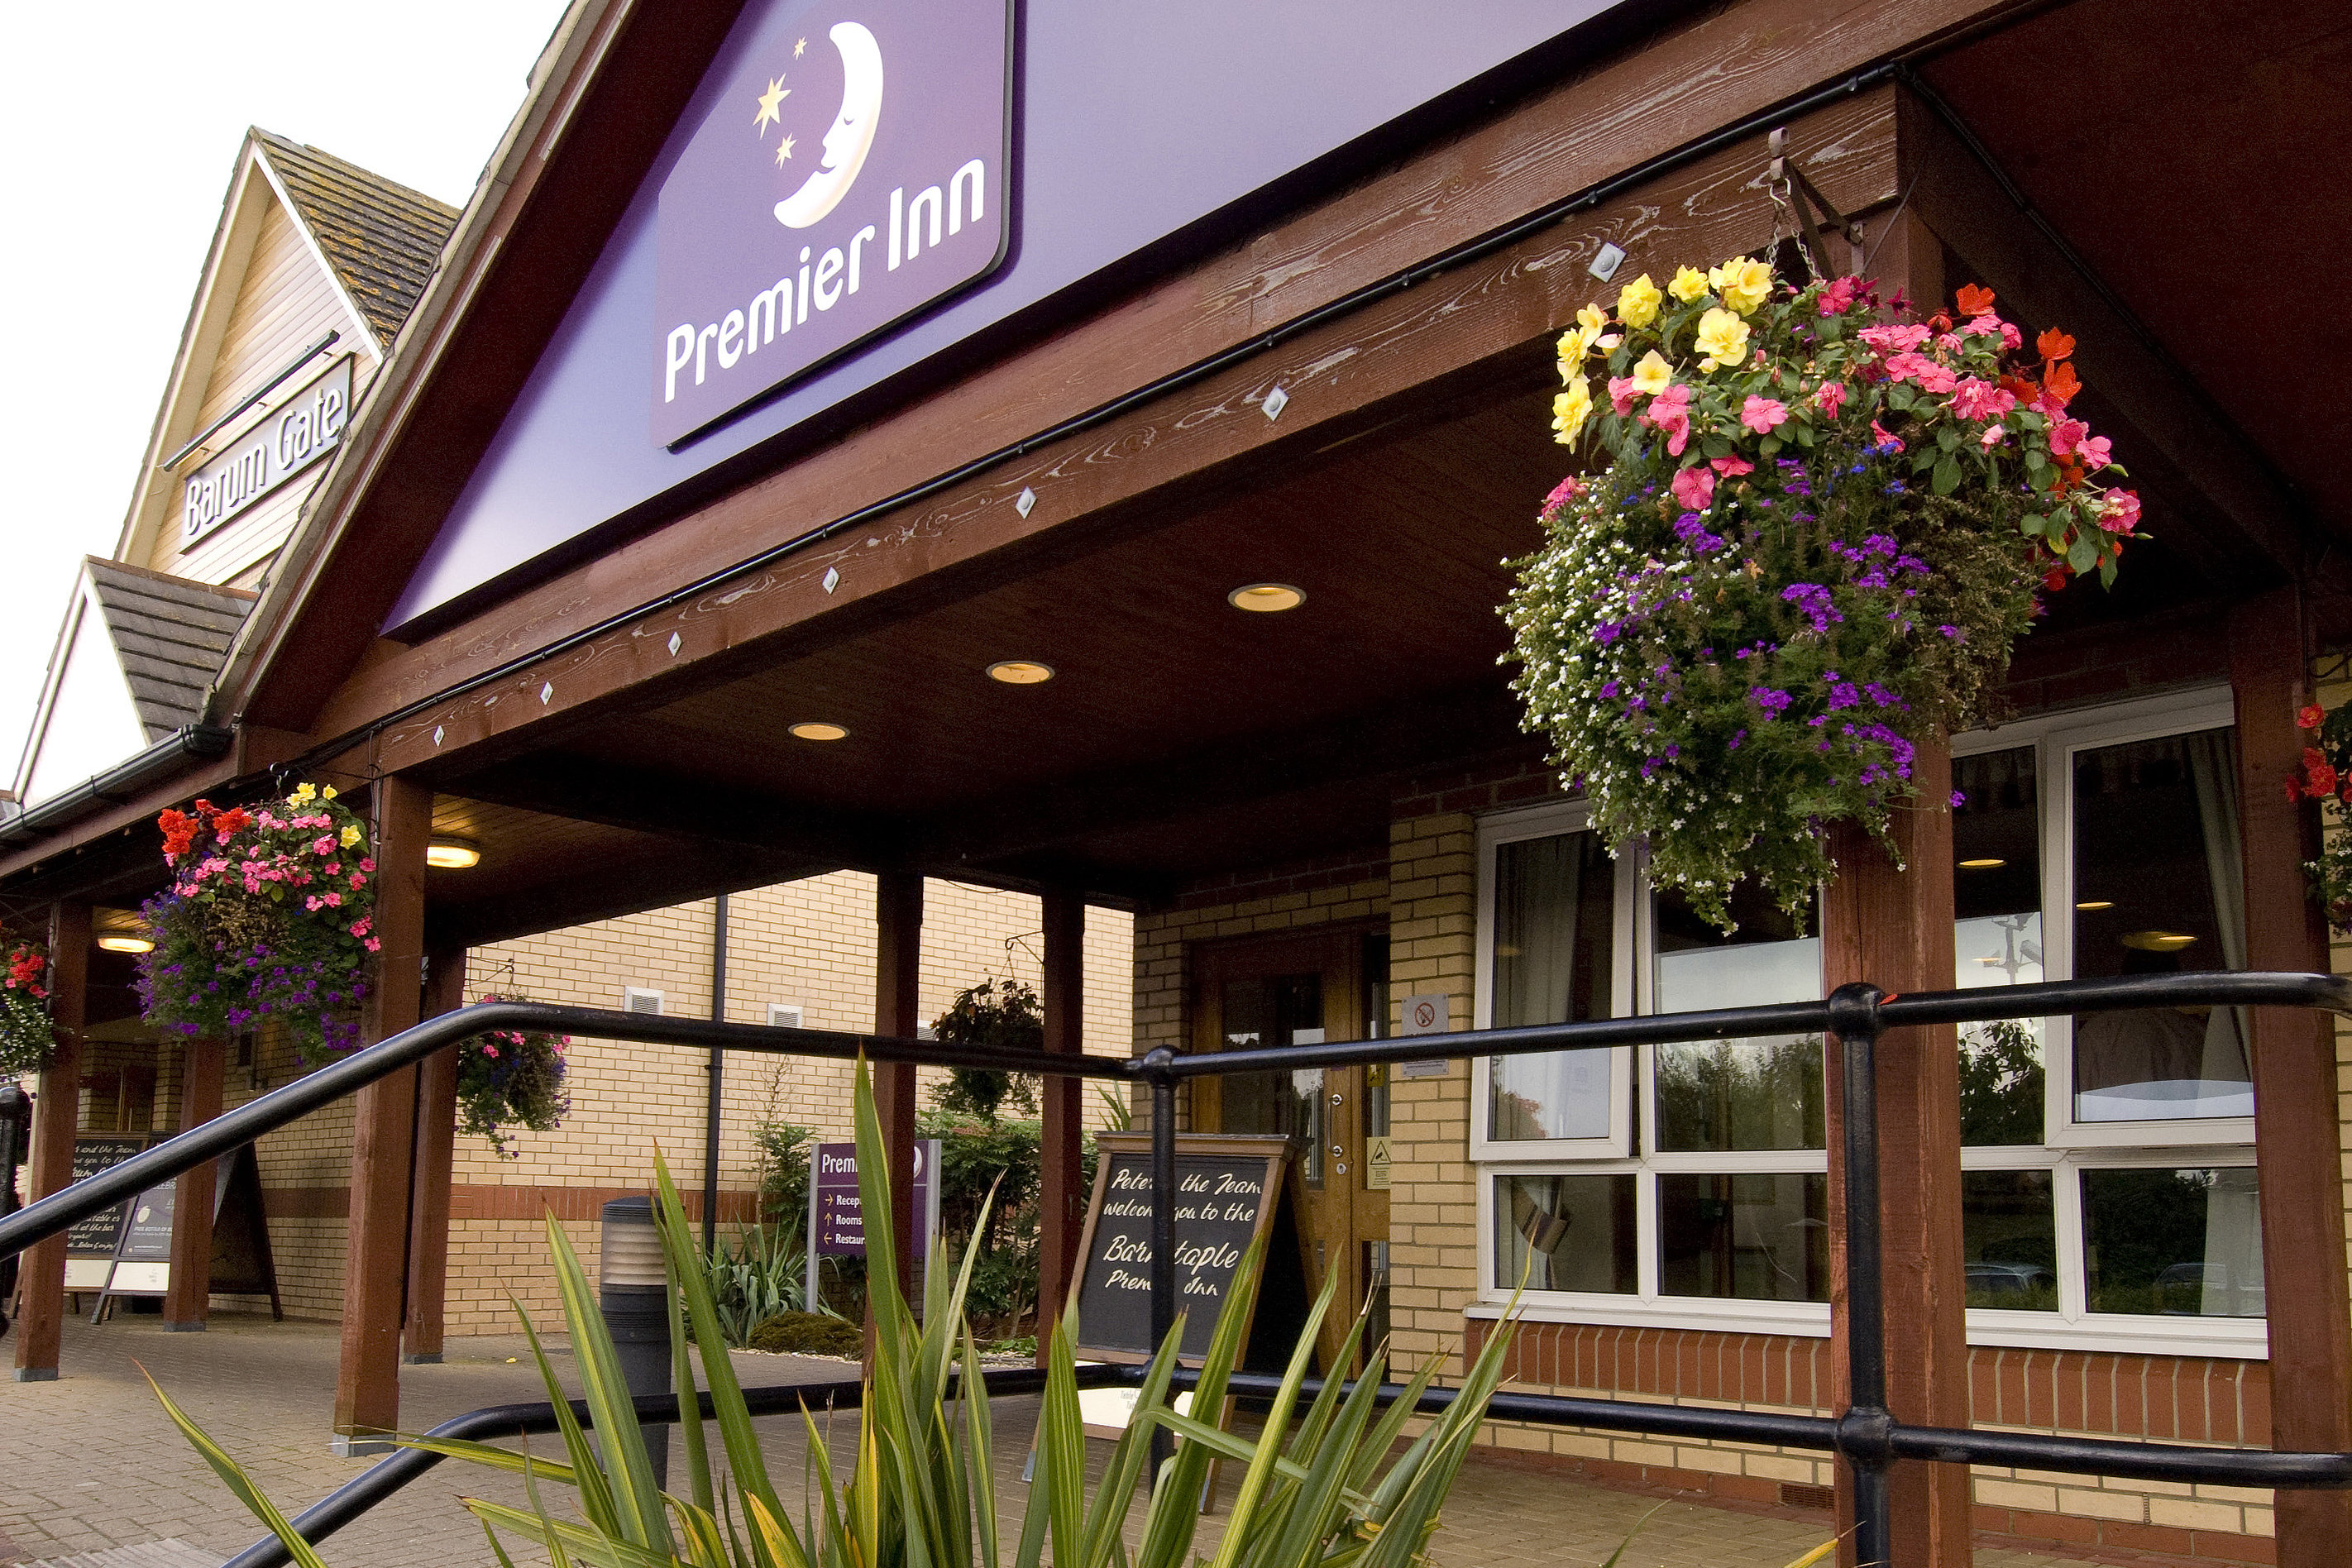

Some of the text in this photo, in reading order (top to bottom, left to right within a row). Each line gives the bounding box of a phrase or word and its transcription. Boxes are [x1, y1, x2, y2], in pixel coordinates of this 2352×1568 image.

[665, 158, 984, 404] Premier Inn
[184, 388, 342, 535] Barum Gate
[821, 1154, 858, 1174] Prem
[1180, 1174, 1209, 1193] the
[1213, 1173, 1262, 1195] Team
[836, 1195, 861, 1208] Recep
[1103, 1199, 1152, 1217] welco
[1200, 1203, 1219, 1221] to
[1223, 1202, 1255, 1221] the
[836, 1214, 863, 1225] Rooms
[835, 1233, 865, 1245] Restaur
[1102, 1235, 1239, 1275] Bartaple
[1105, 1269, 1219, 1296] Prem Inn
